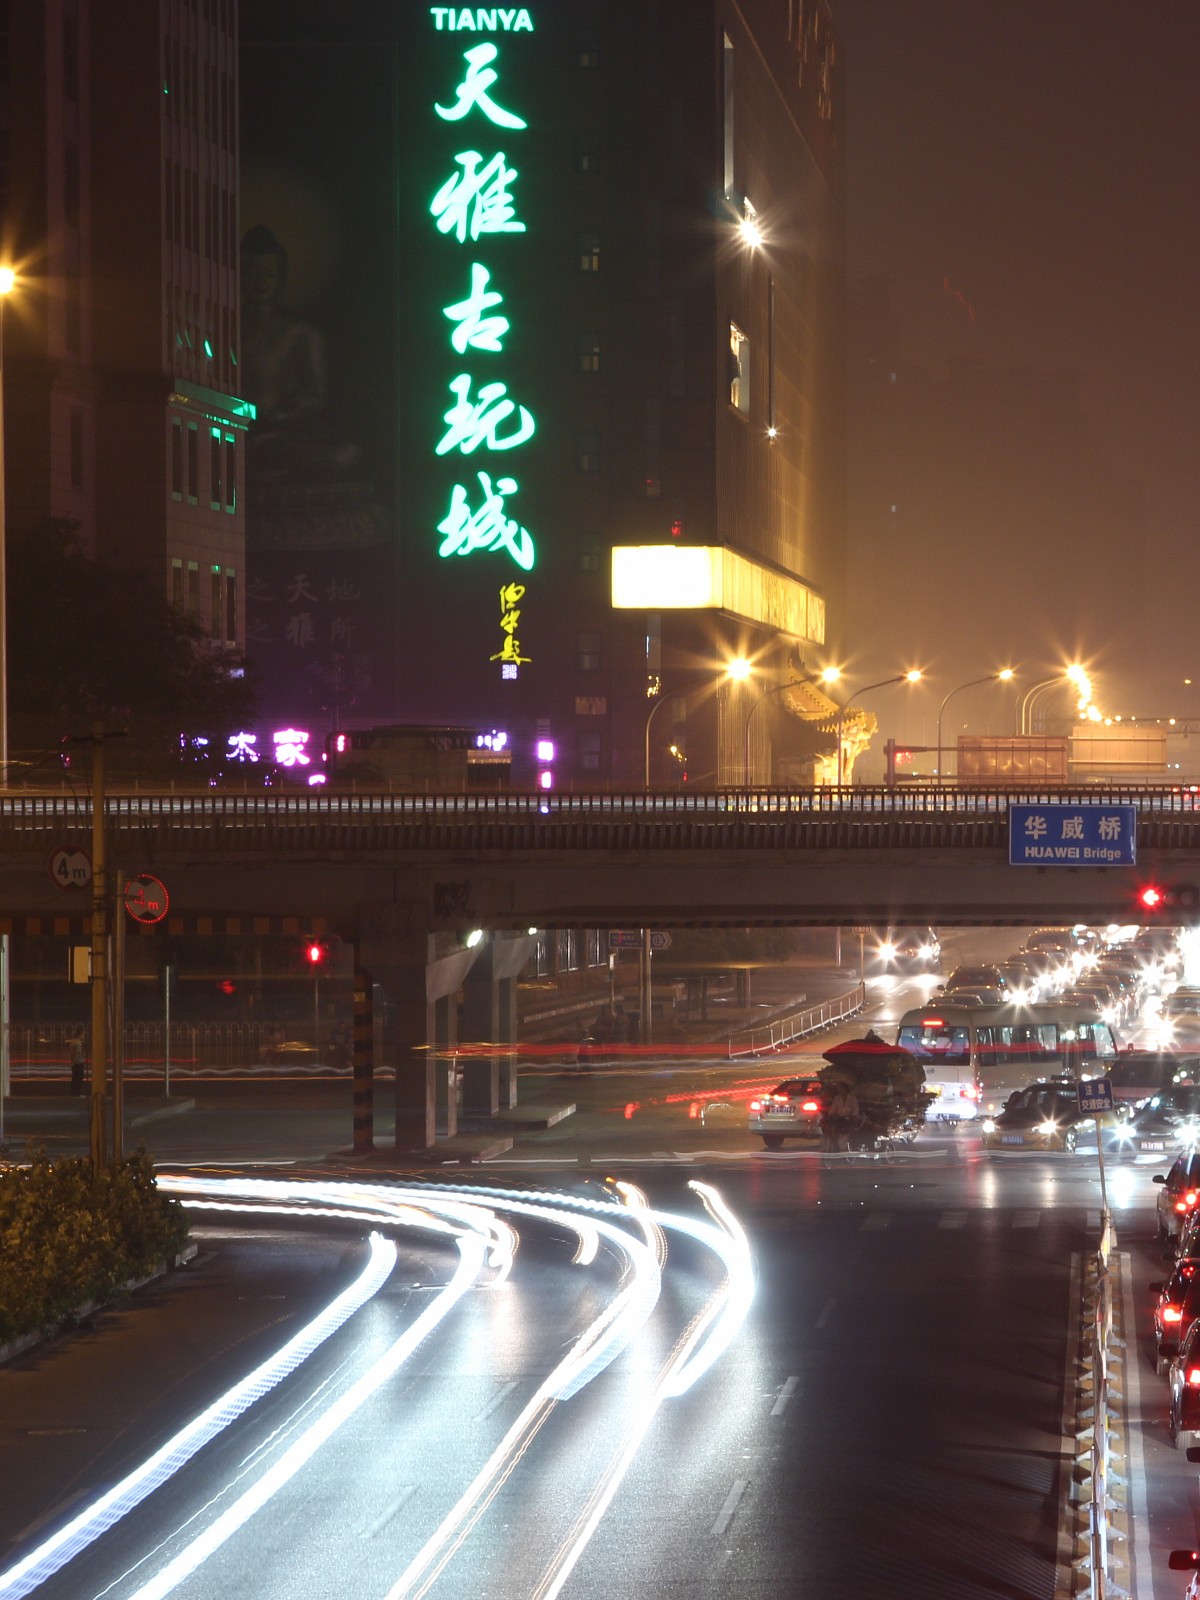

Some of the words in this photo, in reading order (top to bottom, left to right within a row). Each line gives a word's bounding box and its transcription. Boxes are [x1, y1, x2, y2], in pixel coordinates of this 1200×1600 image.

[430, 7, 534, 31] TIANYA
[430, 42, 536, 571] 天雅古玩城
[1024, 815, 1121, 840] 华威桥
[1025, 847, 1079, 858] HUAWEI
[1083, 848, 1121, 860] Bridge
[1081, 1098, 1111, 1110] 交通安全
